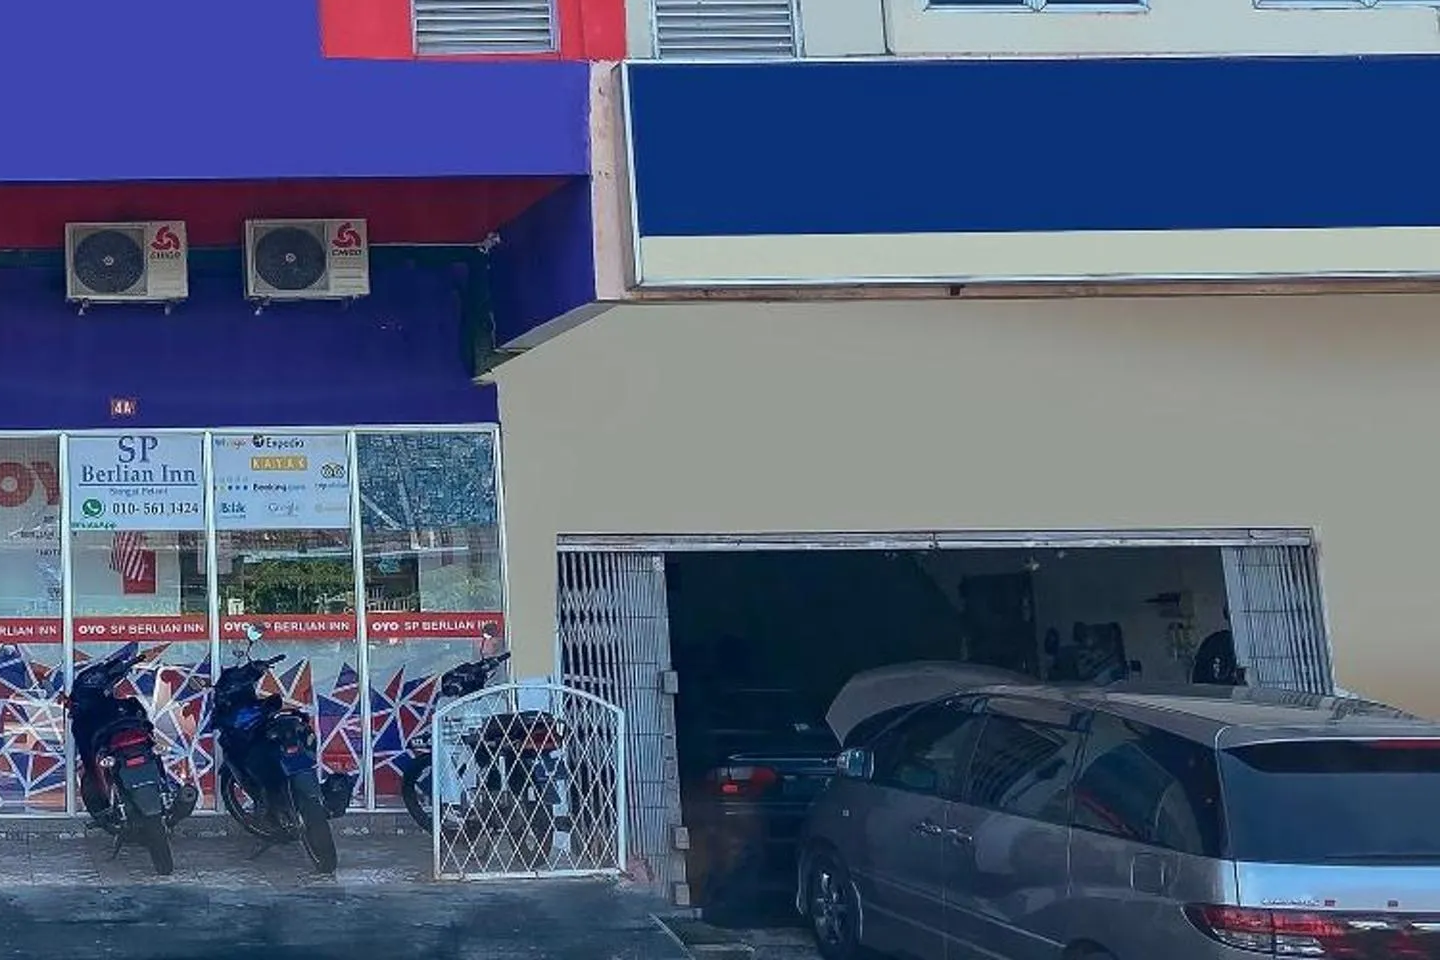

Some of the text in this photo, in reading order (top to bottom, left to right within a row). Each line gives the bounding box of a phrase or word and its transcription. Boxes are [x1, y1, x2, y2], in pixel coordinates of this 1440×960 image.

[118, 435, 158, 463] SP
[253, 458, 305, 469] KAYAK
[82, 464, 196, 482] Berlian Inn
[79, 625, 105, 634] OYO
[129, 624, 181, 634] BERLIAN
[372, 622, 398, 631] OYO
